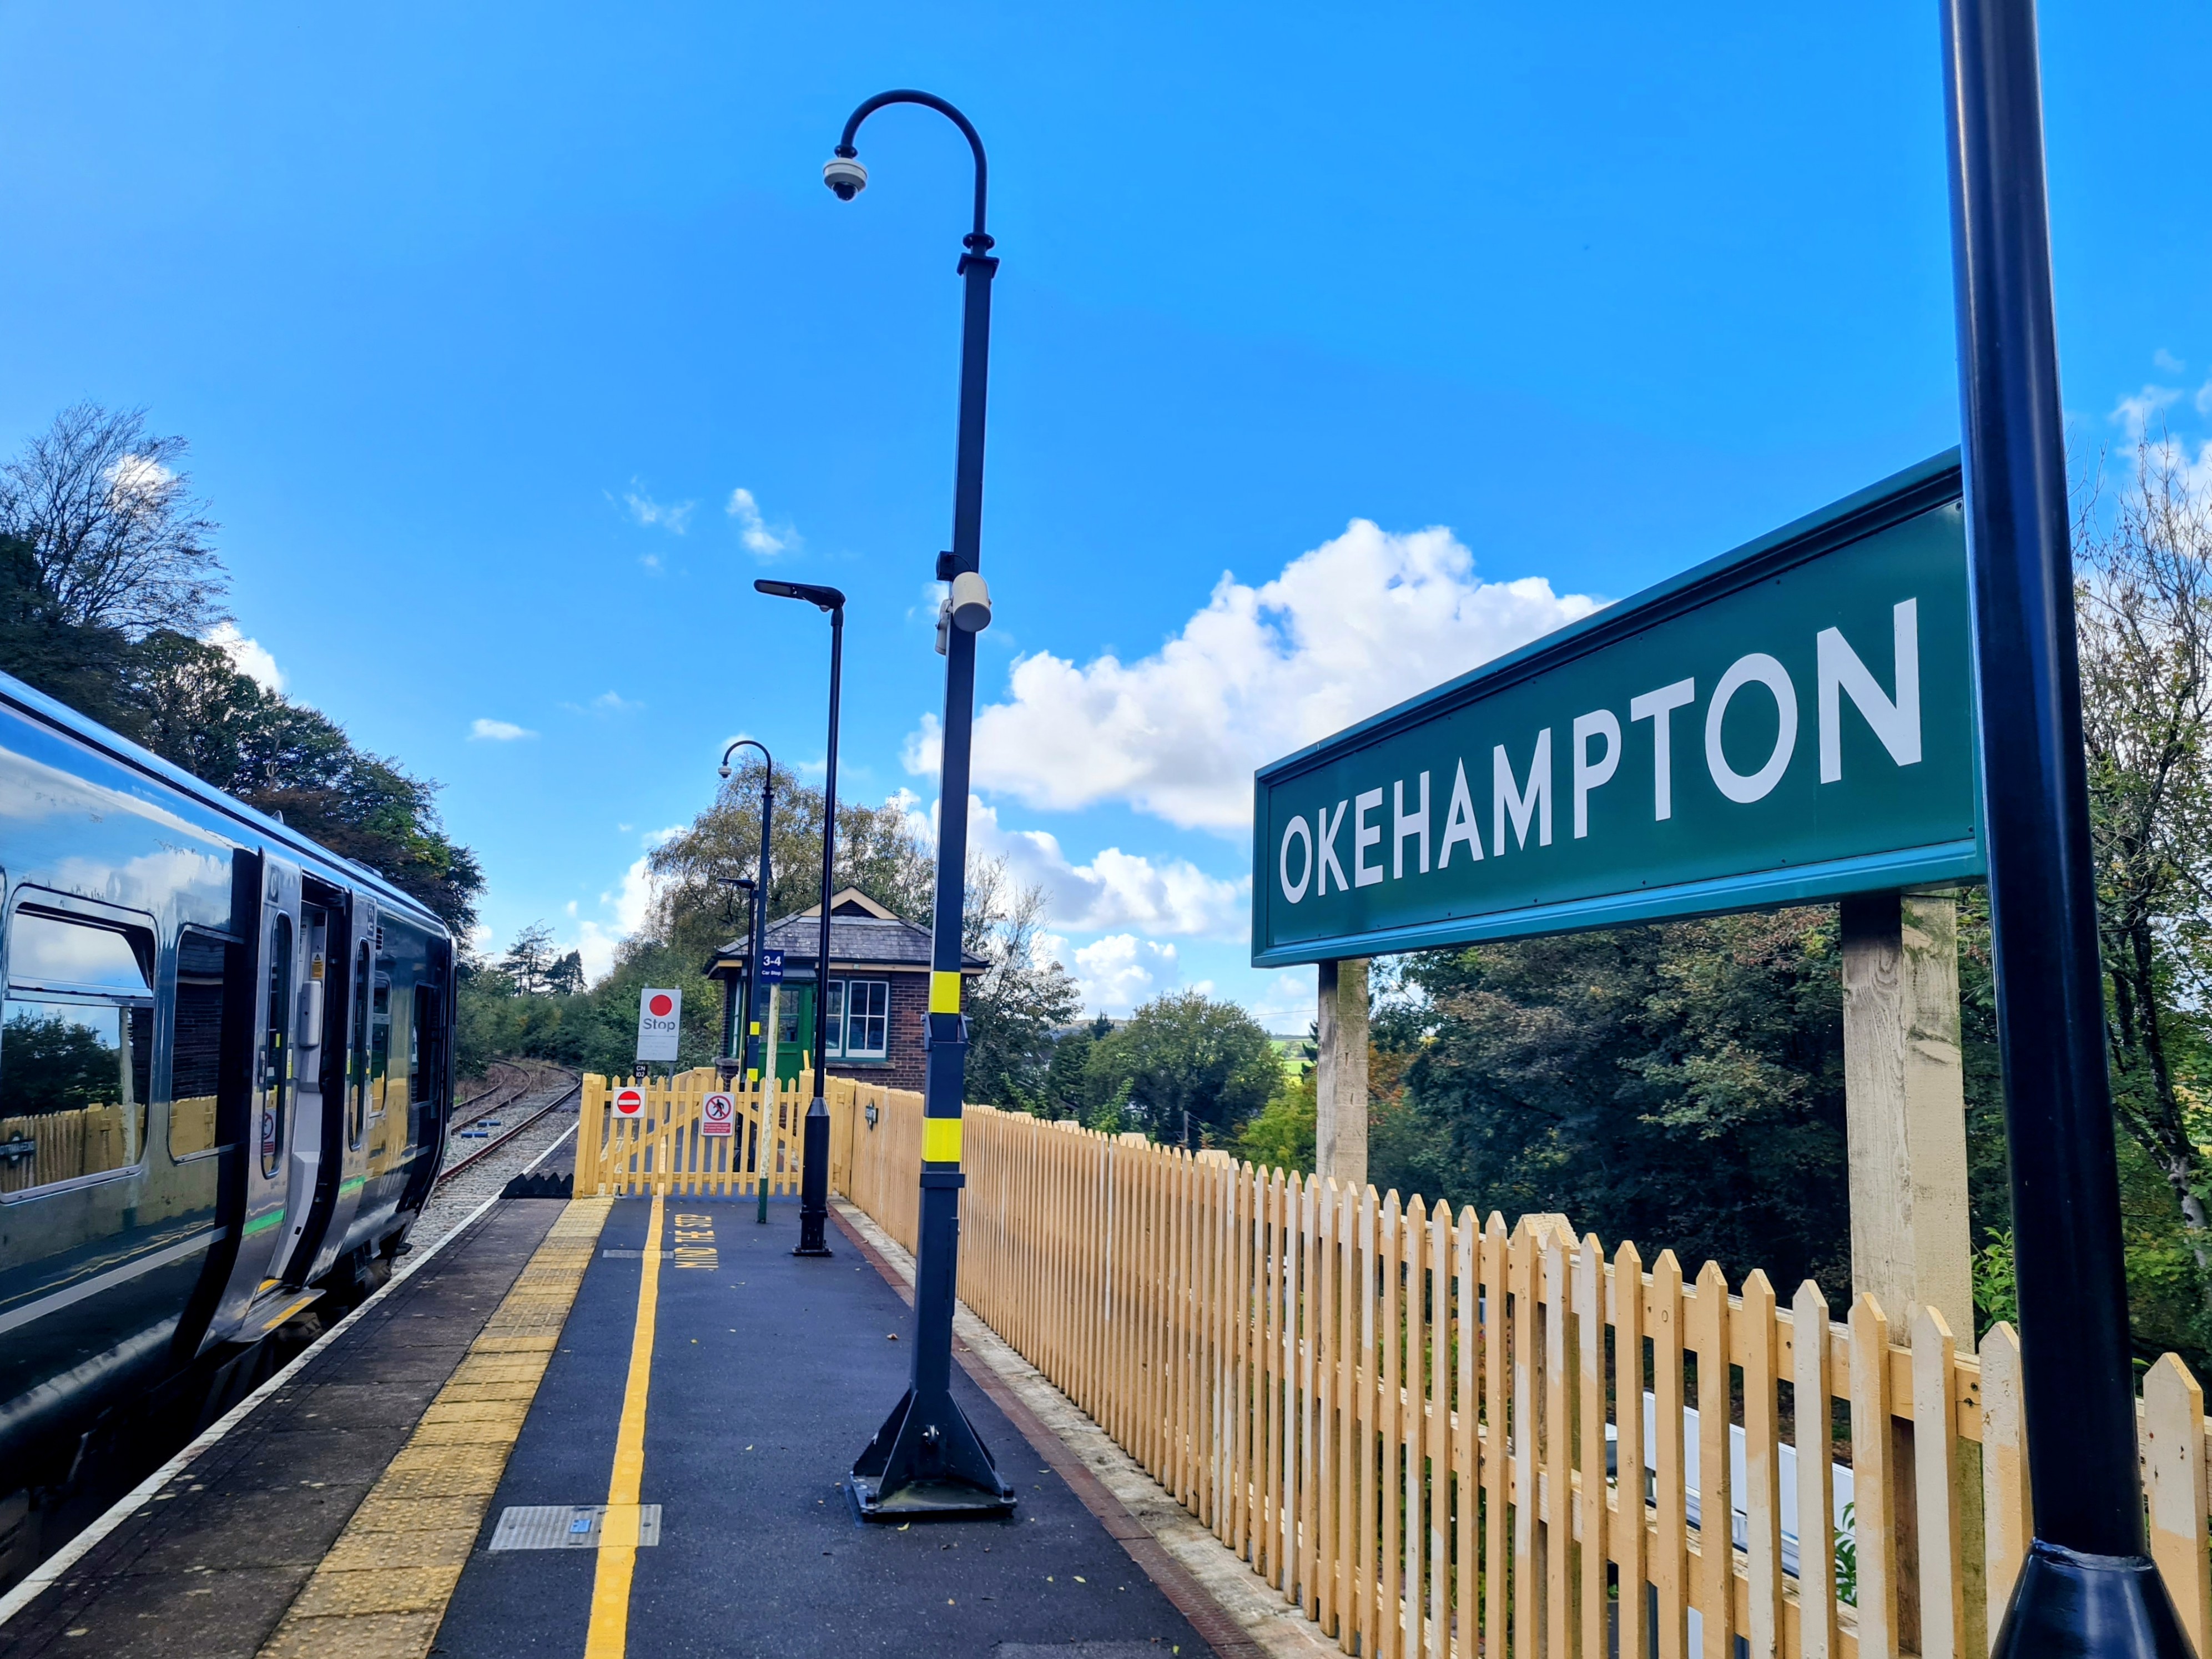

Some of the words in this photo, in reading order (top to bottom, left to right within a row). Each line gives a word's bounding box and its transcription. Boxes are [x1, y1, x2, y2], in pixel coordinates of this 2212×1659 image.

[1280, 597, 1922, 904] OKEHAMPTON
[763, 955, 781, 966] 3-4
[643, 1018, 676, 1032] Stop
[674, 1213, 712, 1227] STEP
[674, 1230, 715, 1242] THE
[674, 1247, 719, 1268] MIND
